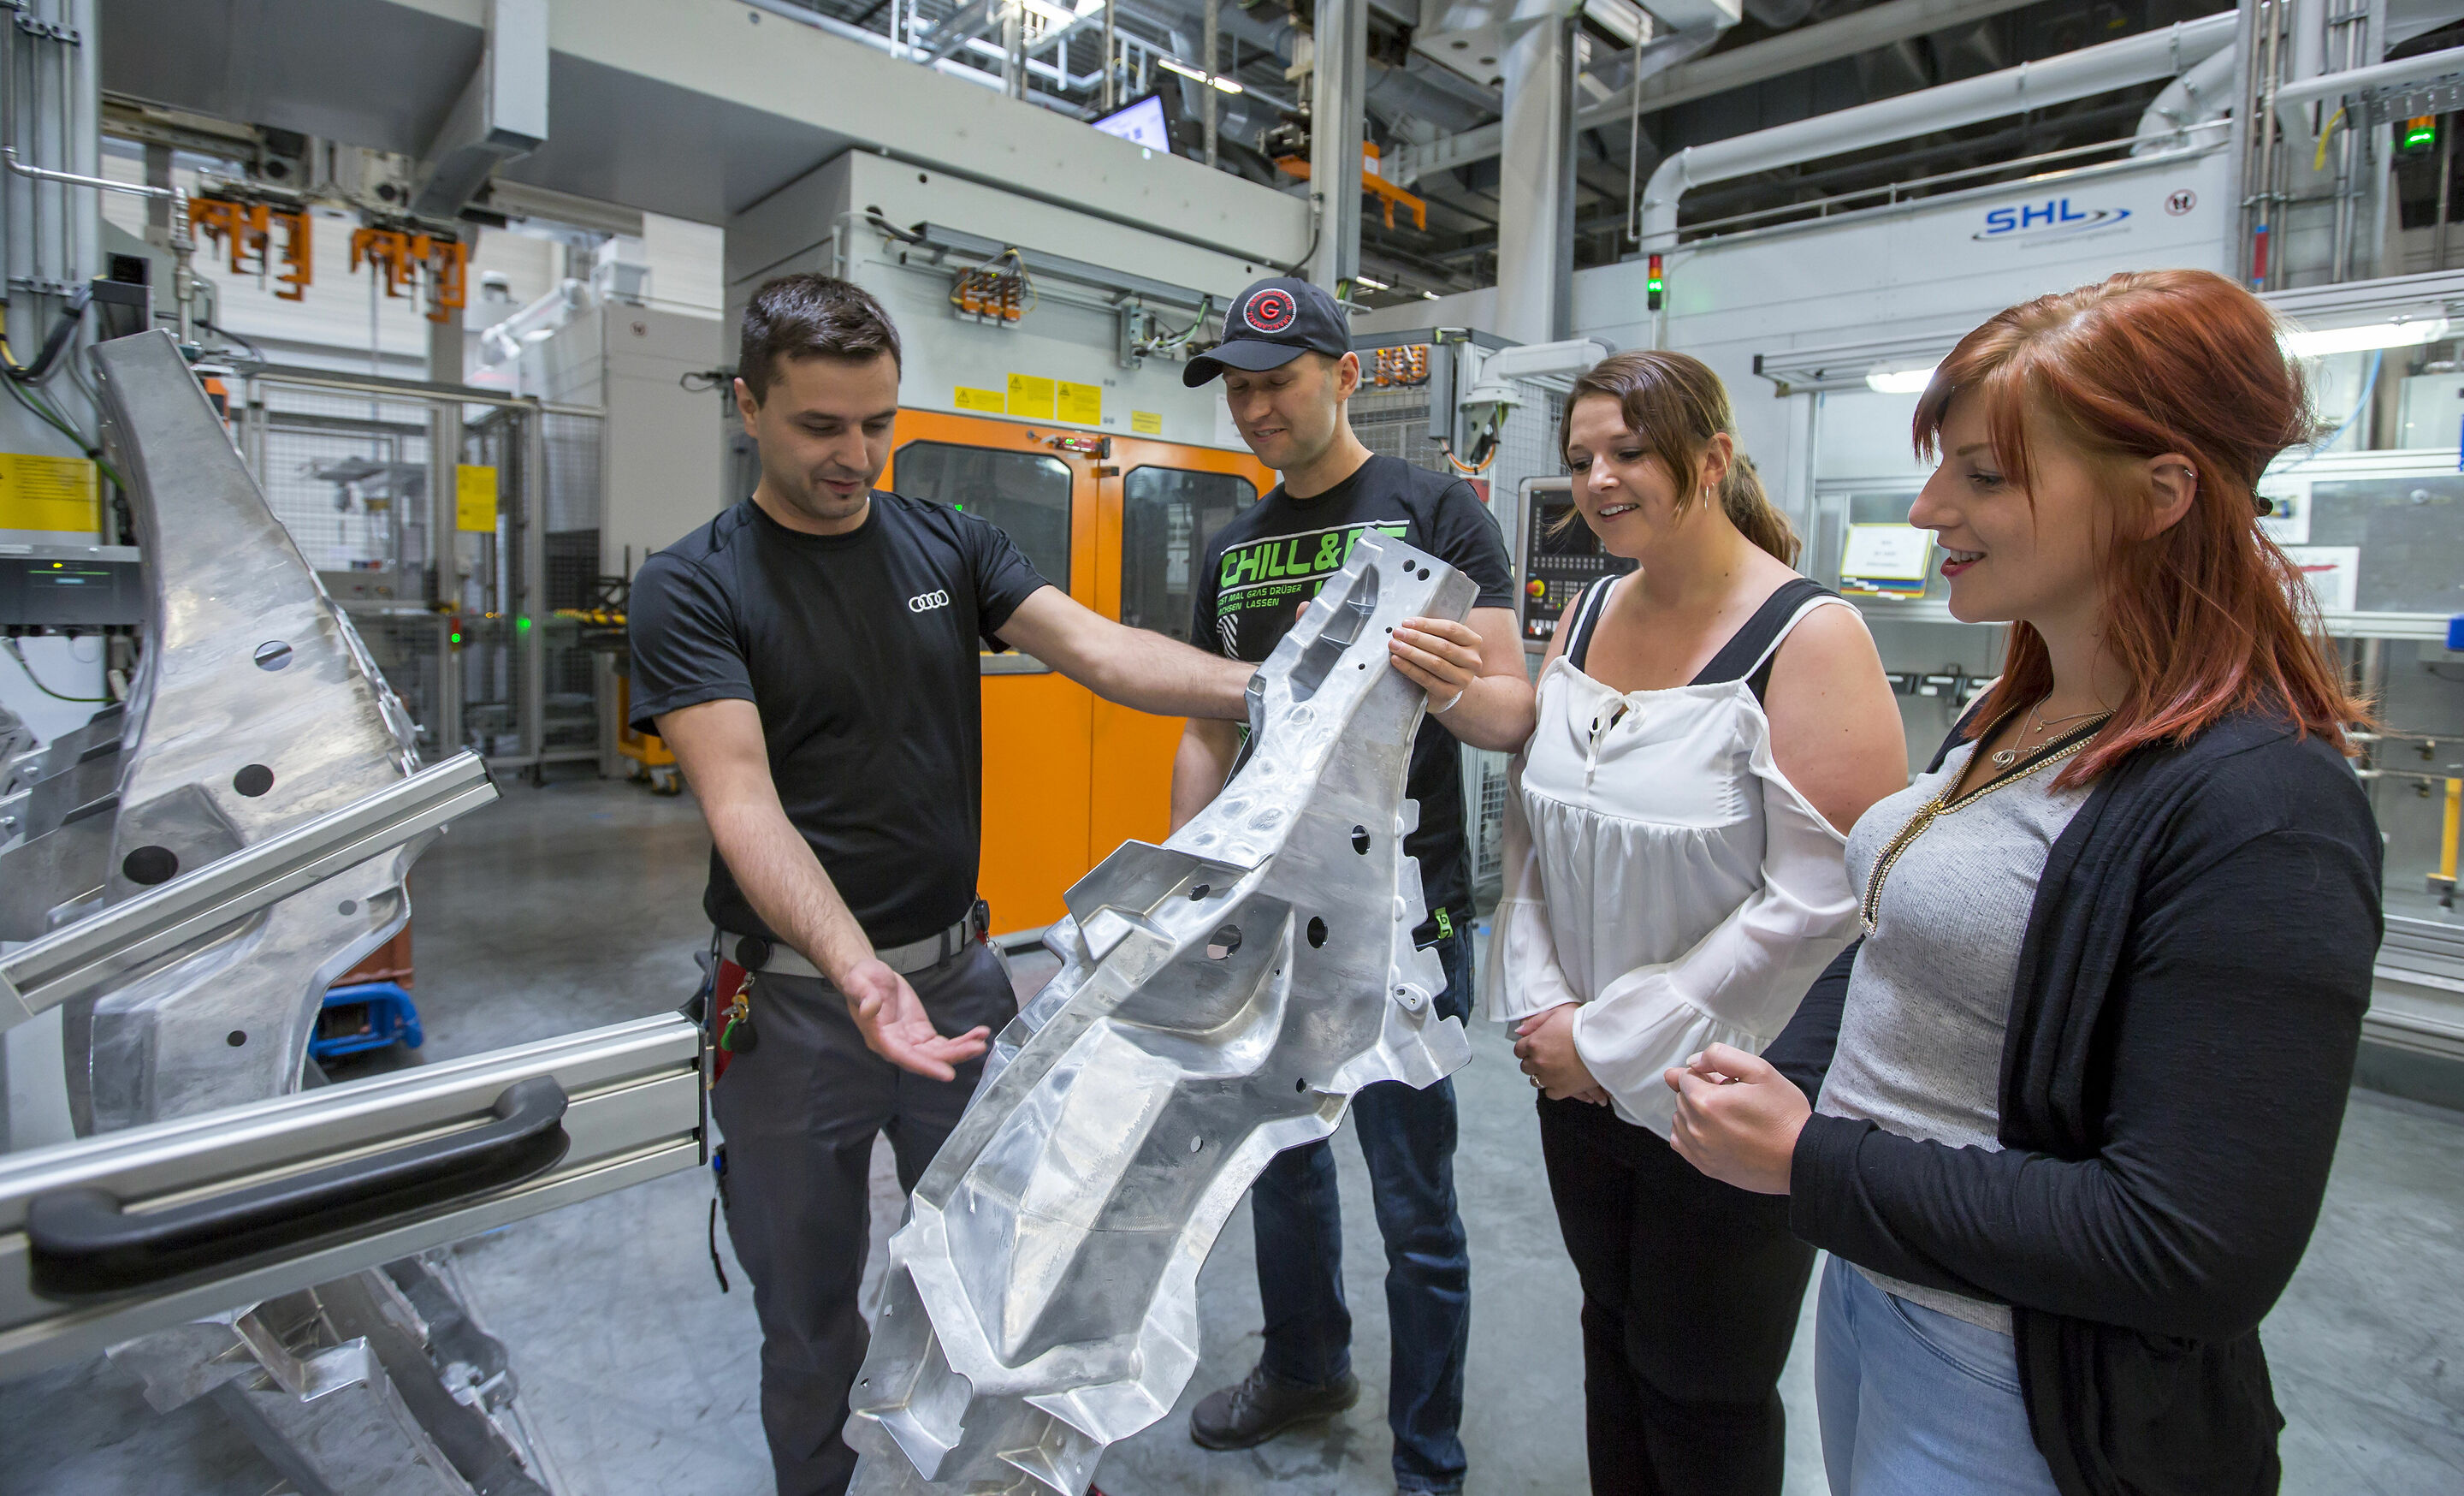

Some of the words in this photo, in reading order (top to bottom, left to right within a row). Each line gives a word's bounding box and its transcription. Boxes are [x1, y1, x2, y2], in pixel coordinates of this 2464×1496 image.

[1987, 199, 2086, 234] SHL
[1259, 300, 1280, 320] G
[1221, 539, 1311, 588] CHILL
[1228, 591, 1245, 603] MAL
[1247, 587, 1267, 598] GRAS
[1269, 584, 1302, 596] DRÜBER
[1217, 602, 1242, 617] ACHSEN
[1246, 597, 1280, 608] LASSEN
